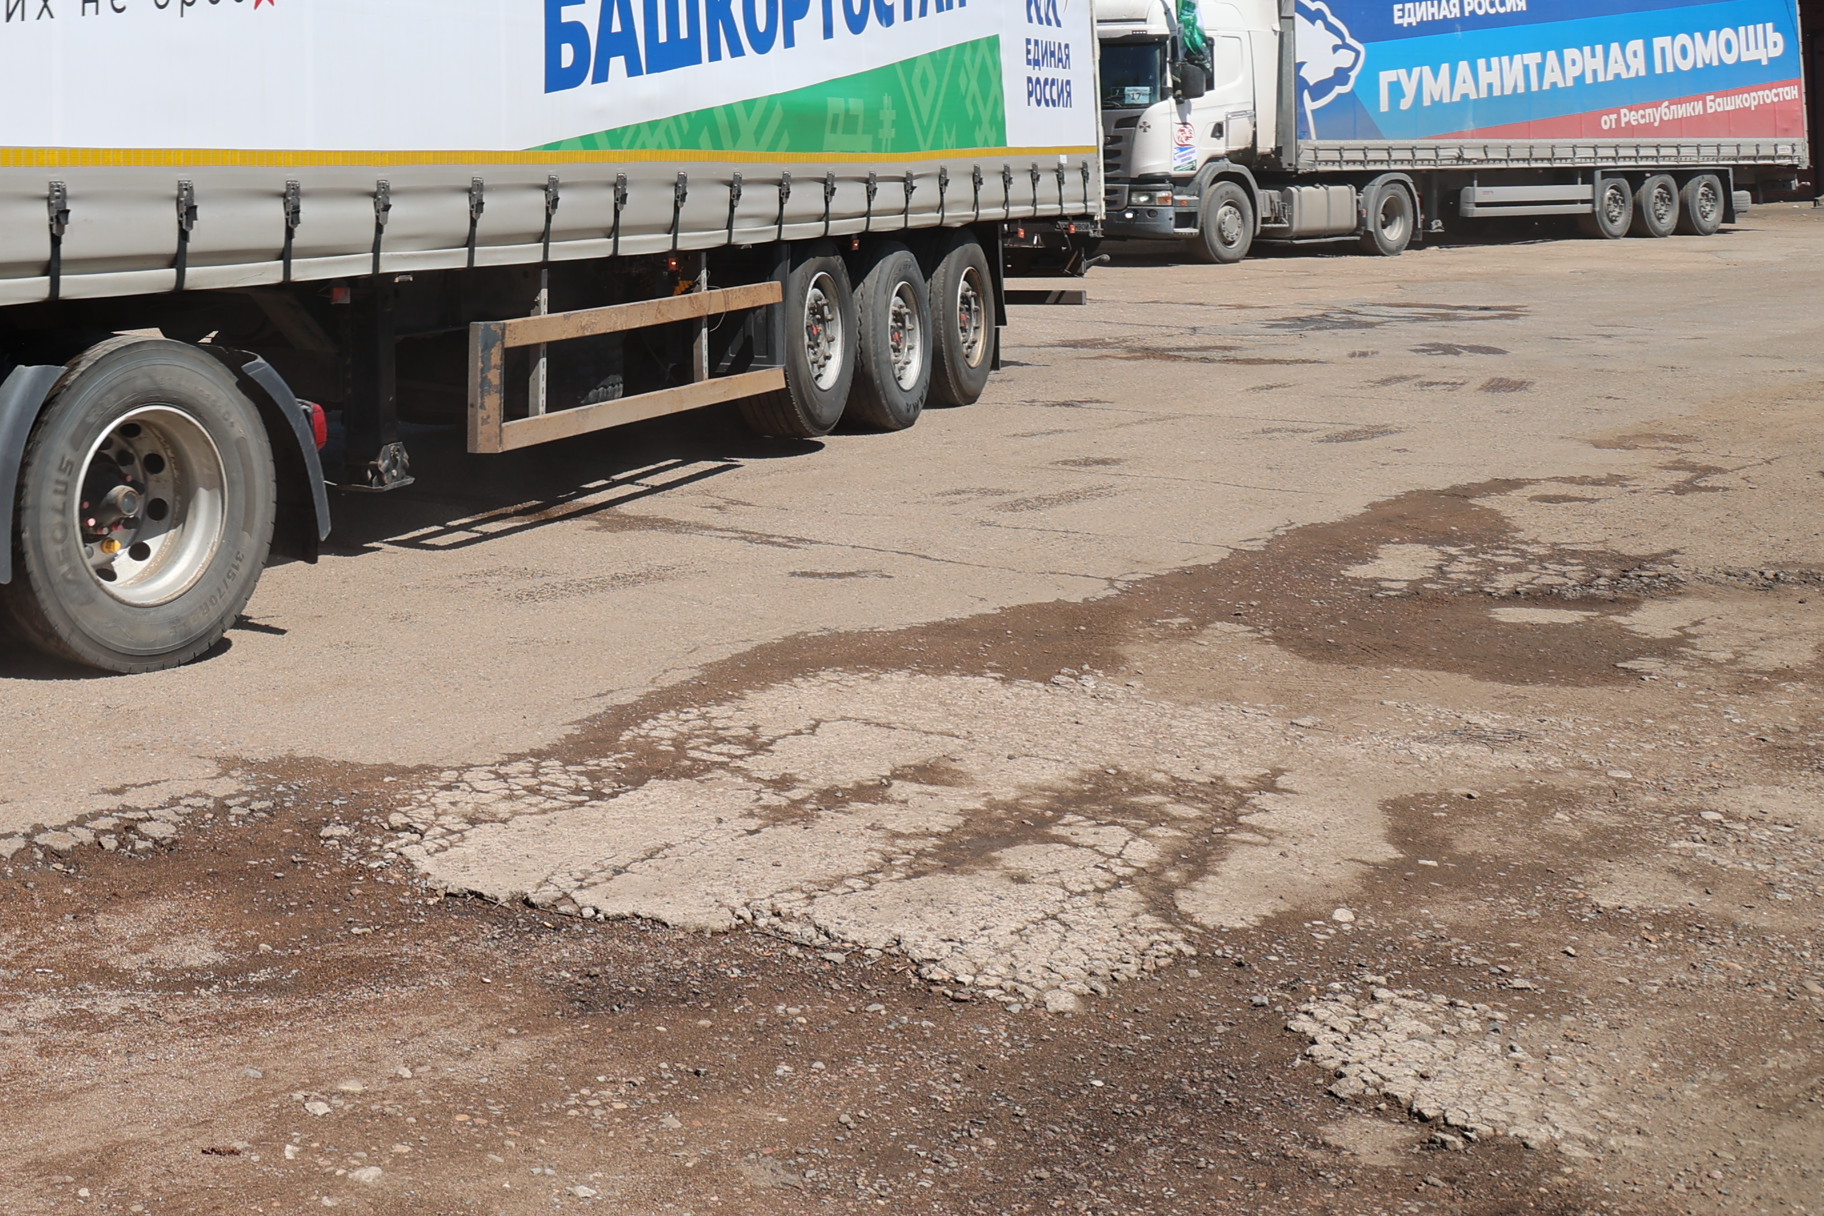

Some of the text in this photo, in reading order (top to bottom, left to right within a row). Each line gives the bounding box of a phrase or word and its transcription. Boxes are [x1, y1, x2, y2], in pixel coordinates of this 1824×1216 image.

[1025, 37, 1071, 71] ЕДИНАЯ
[1378, 22, 1785, 113] ГУМАНИТАРНАЯ ПОМОЩЬ
[1026, 75, 1072, 108] РОССИЯ
[1600, 84, 1799, 130] от Республики Башкортостан
